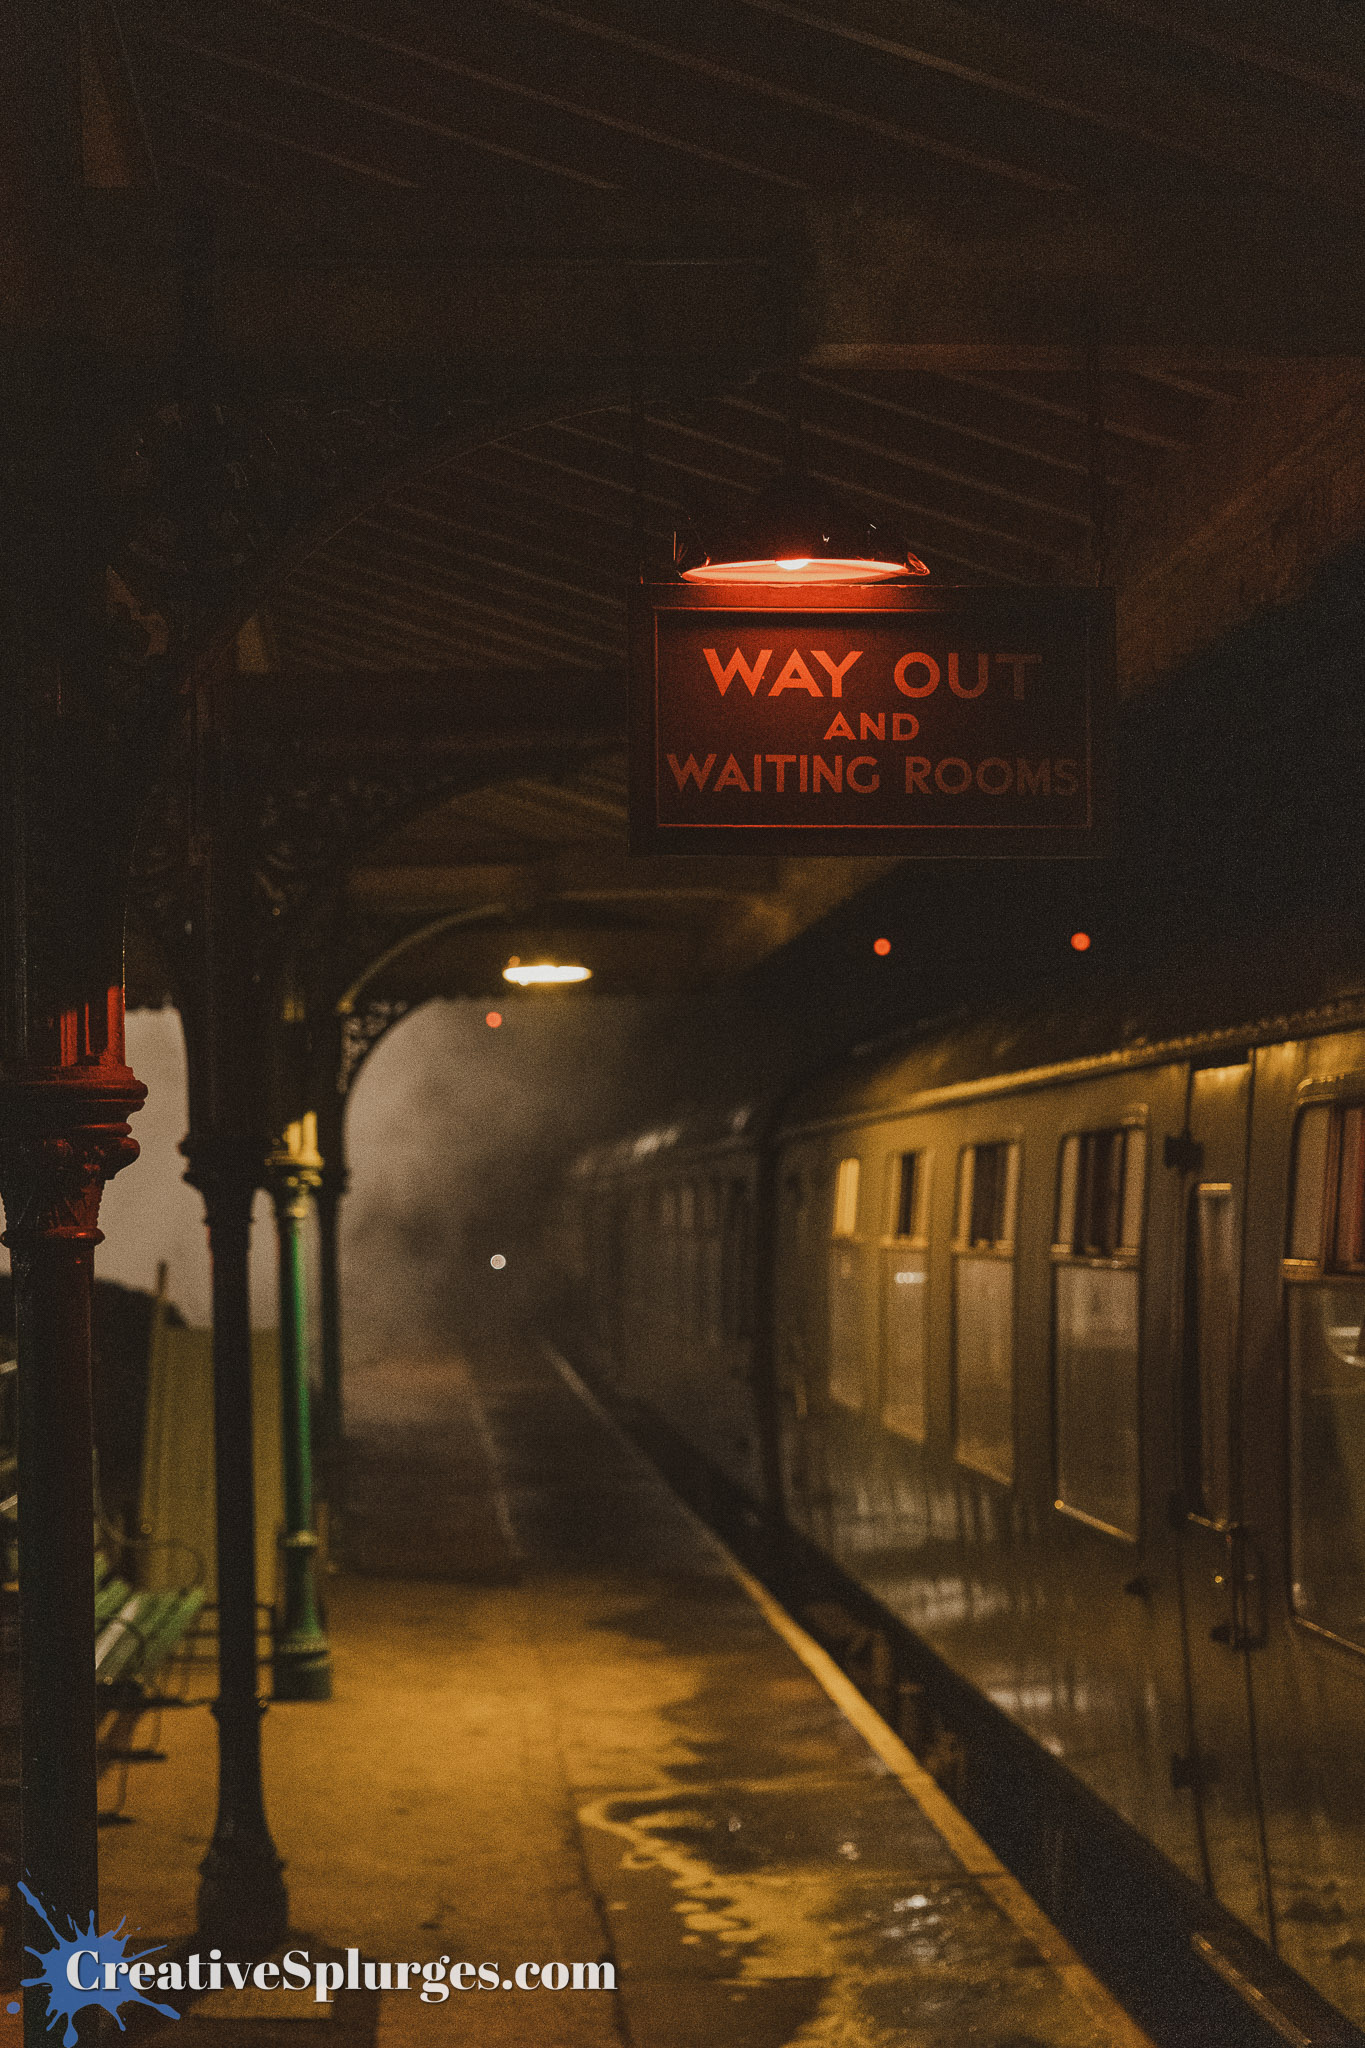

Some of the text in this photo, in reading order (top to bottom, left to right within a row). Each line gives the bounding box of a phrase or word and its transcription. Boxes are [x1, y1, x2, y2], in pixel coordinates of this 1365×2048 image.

[702, 647, 1043, 700] WAY OUT
[823, 711, 921, 742] AND
[666, 753, 1079, 797] WAITING ROOMS
